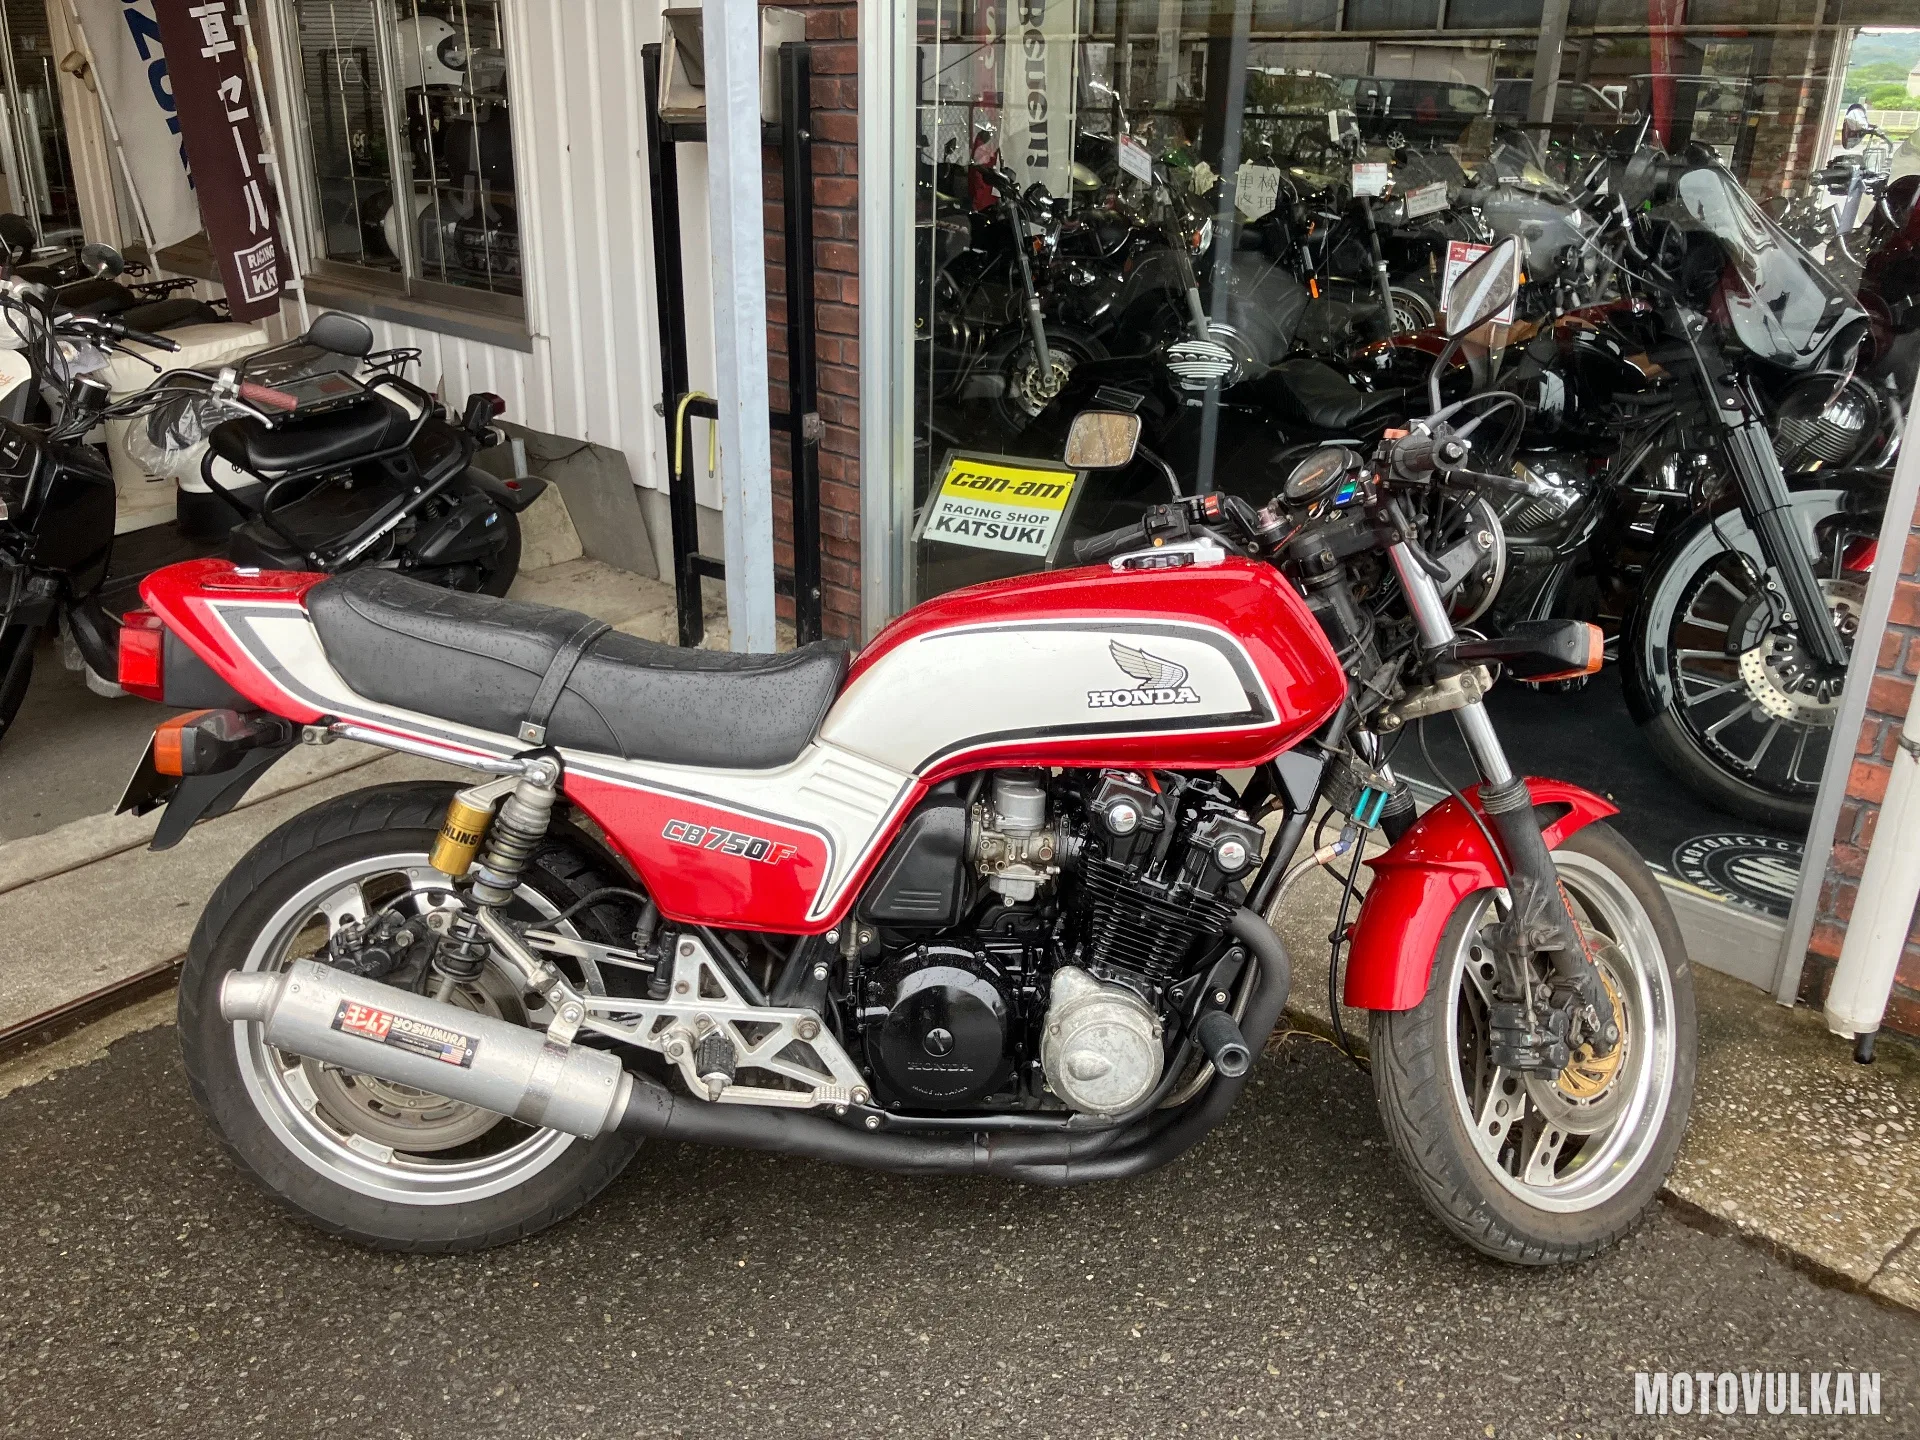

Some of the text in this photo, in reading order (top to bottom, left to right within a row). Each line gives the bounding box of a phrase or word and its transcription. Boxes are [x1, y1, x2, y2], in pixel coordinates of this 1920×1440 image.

[951, 473, 1065, 499] can-am
[942, 503, 1050, 525] RACING SHOP
[935, 516, 1045, 544] KATSUKI
[1088, 686, 1200, 708] HONDA
[662, 819, 798, 865] CB750F
[344, 1004, 393, 1034] ヨシムラ
[392, 1016, 467, 1048] YOSHIMURA
